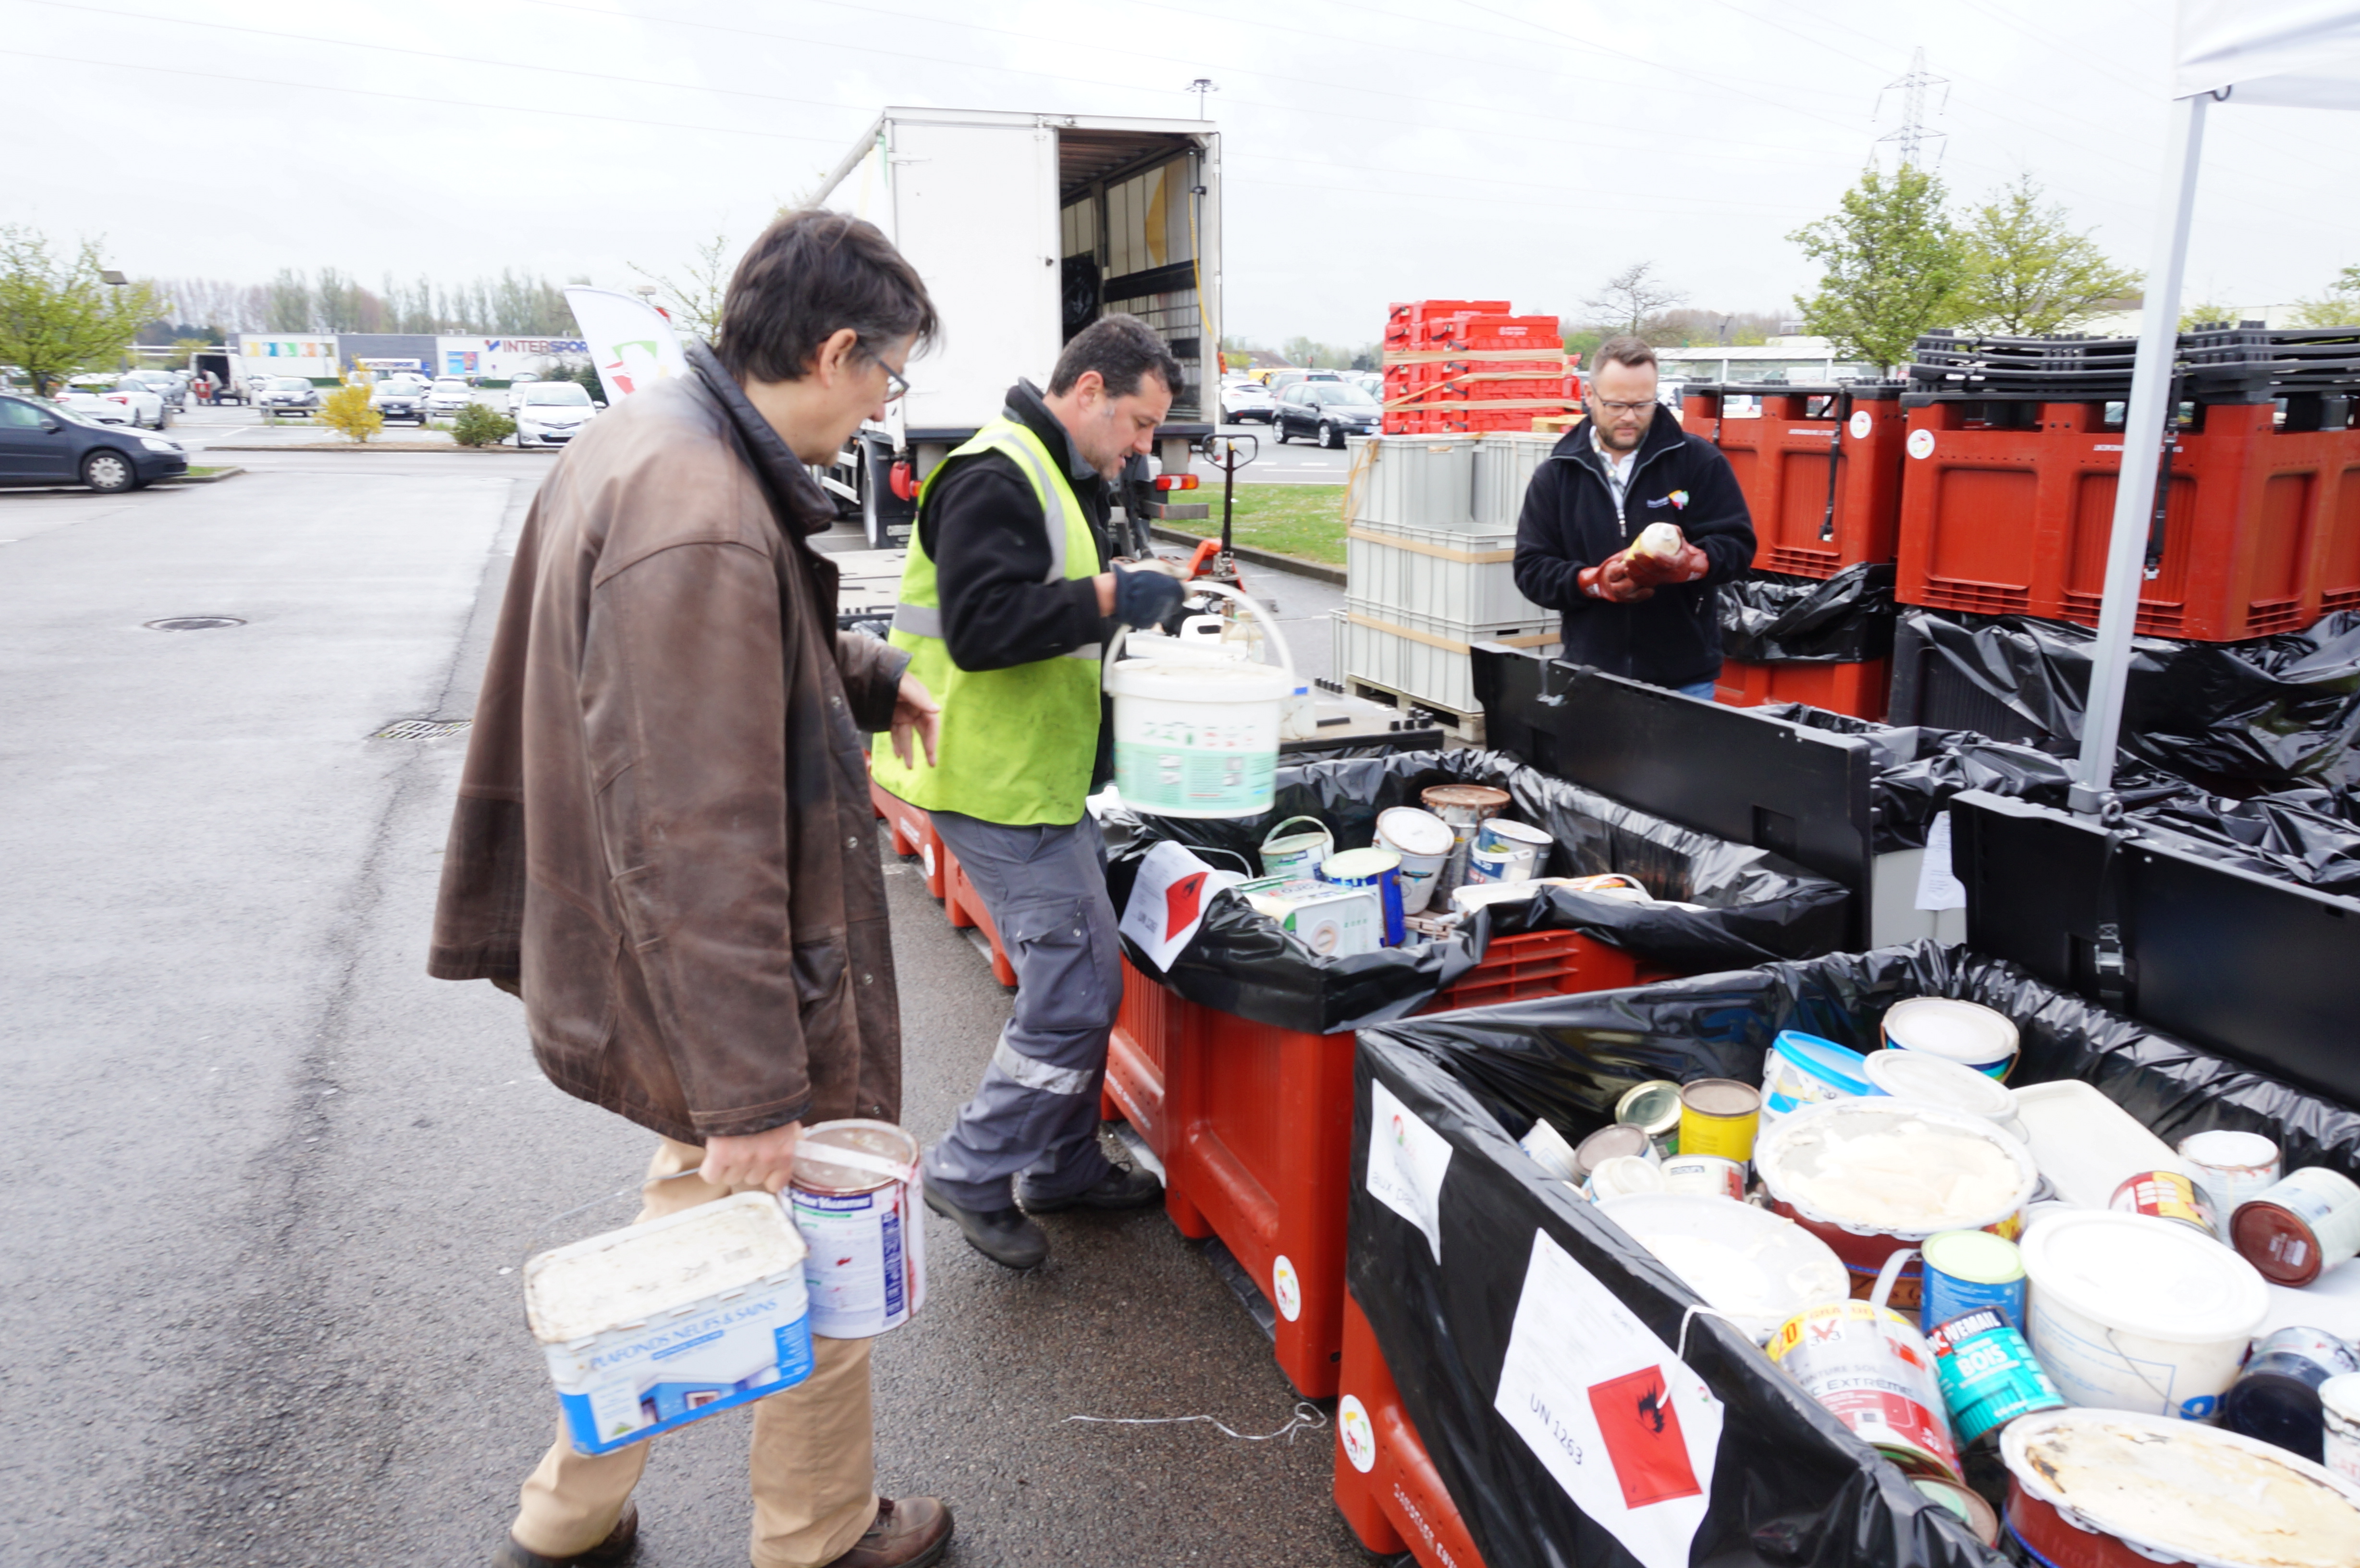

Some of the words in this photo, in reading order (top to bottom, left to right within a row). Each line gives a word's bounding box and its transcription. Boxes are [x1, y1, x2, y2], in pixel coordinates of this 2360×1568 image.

[503, 340, 589, 352] INTERSPOR
[1955, 1344, 2008, 1378] BOIS
[1530, 1393, 1550, 1425] UN
[1553, 1421, 1583, 1465] 1263
